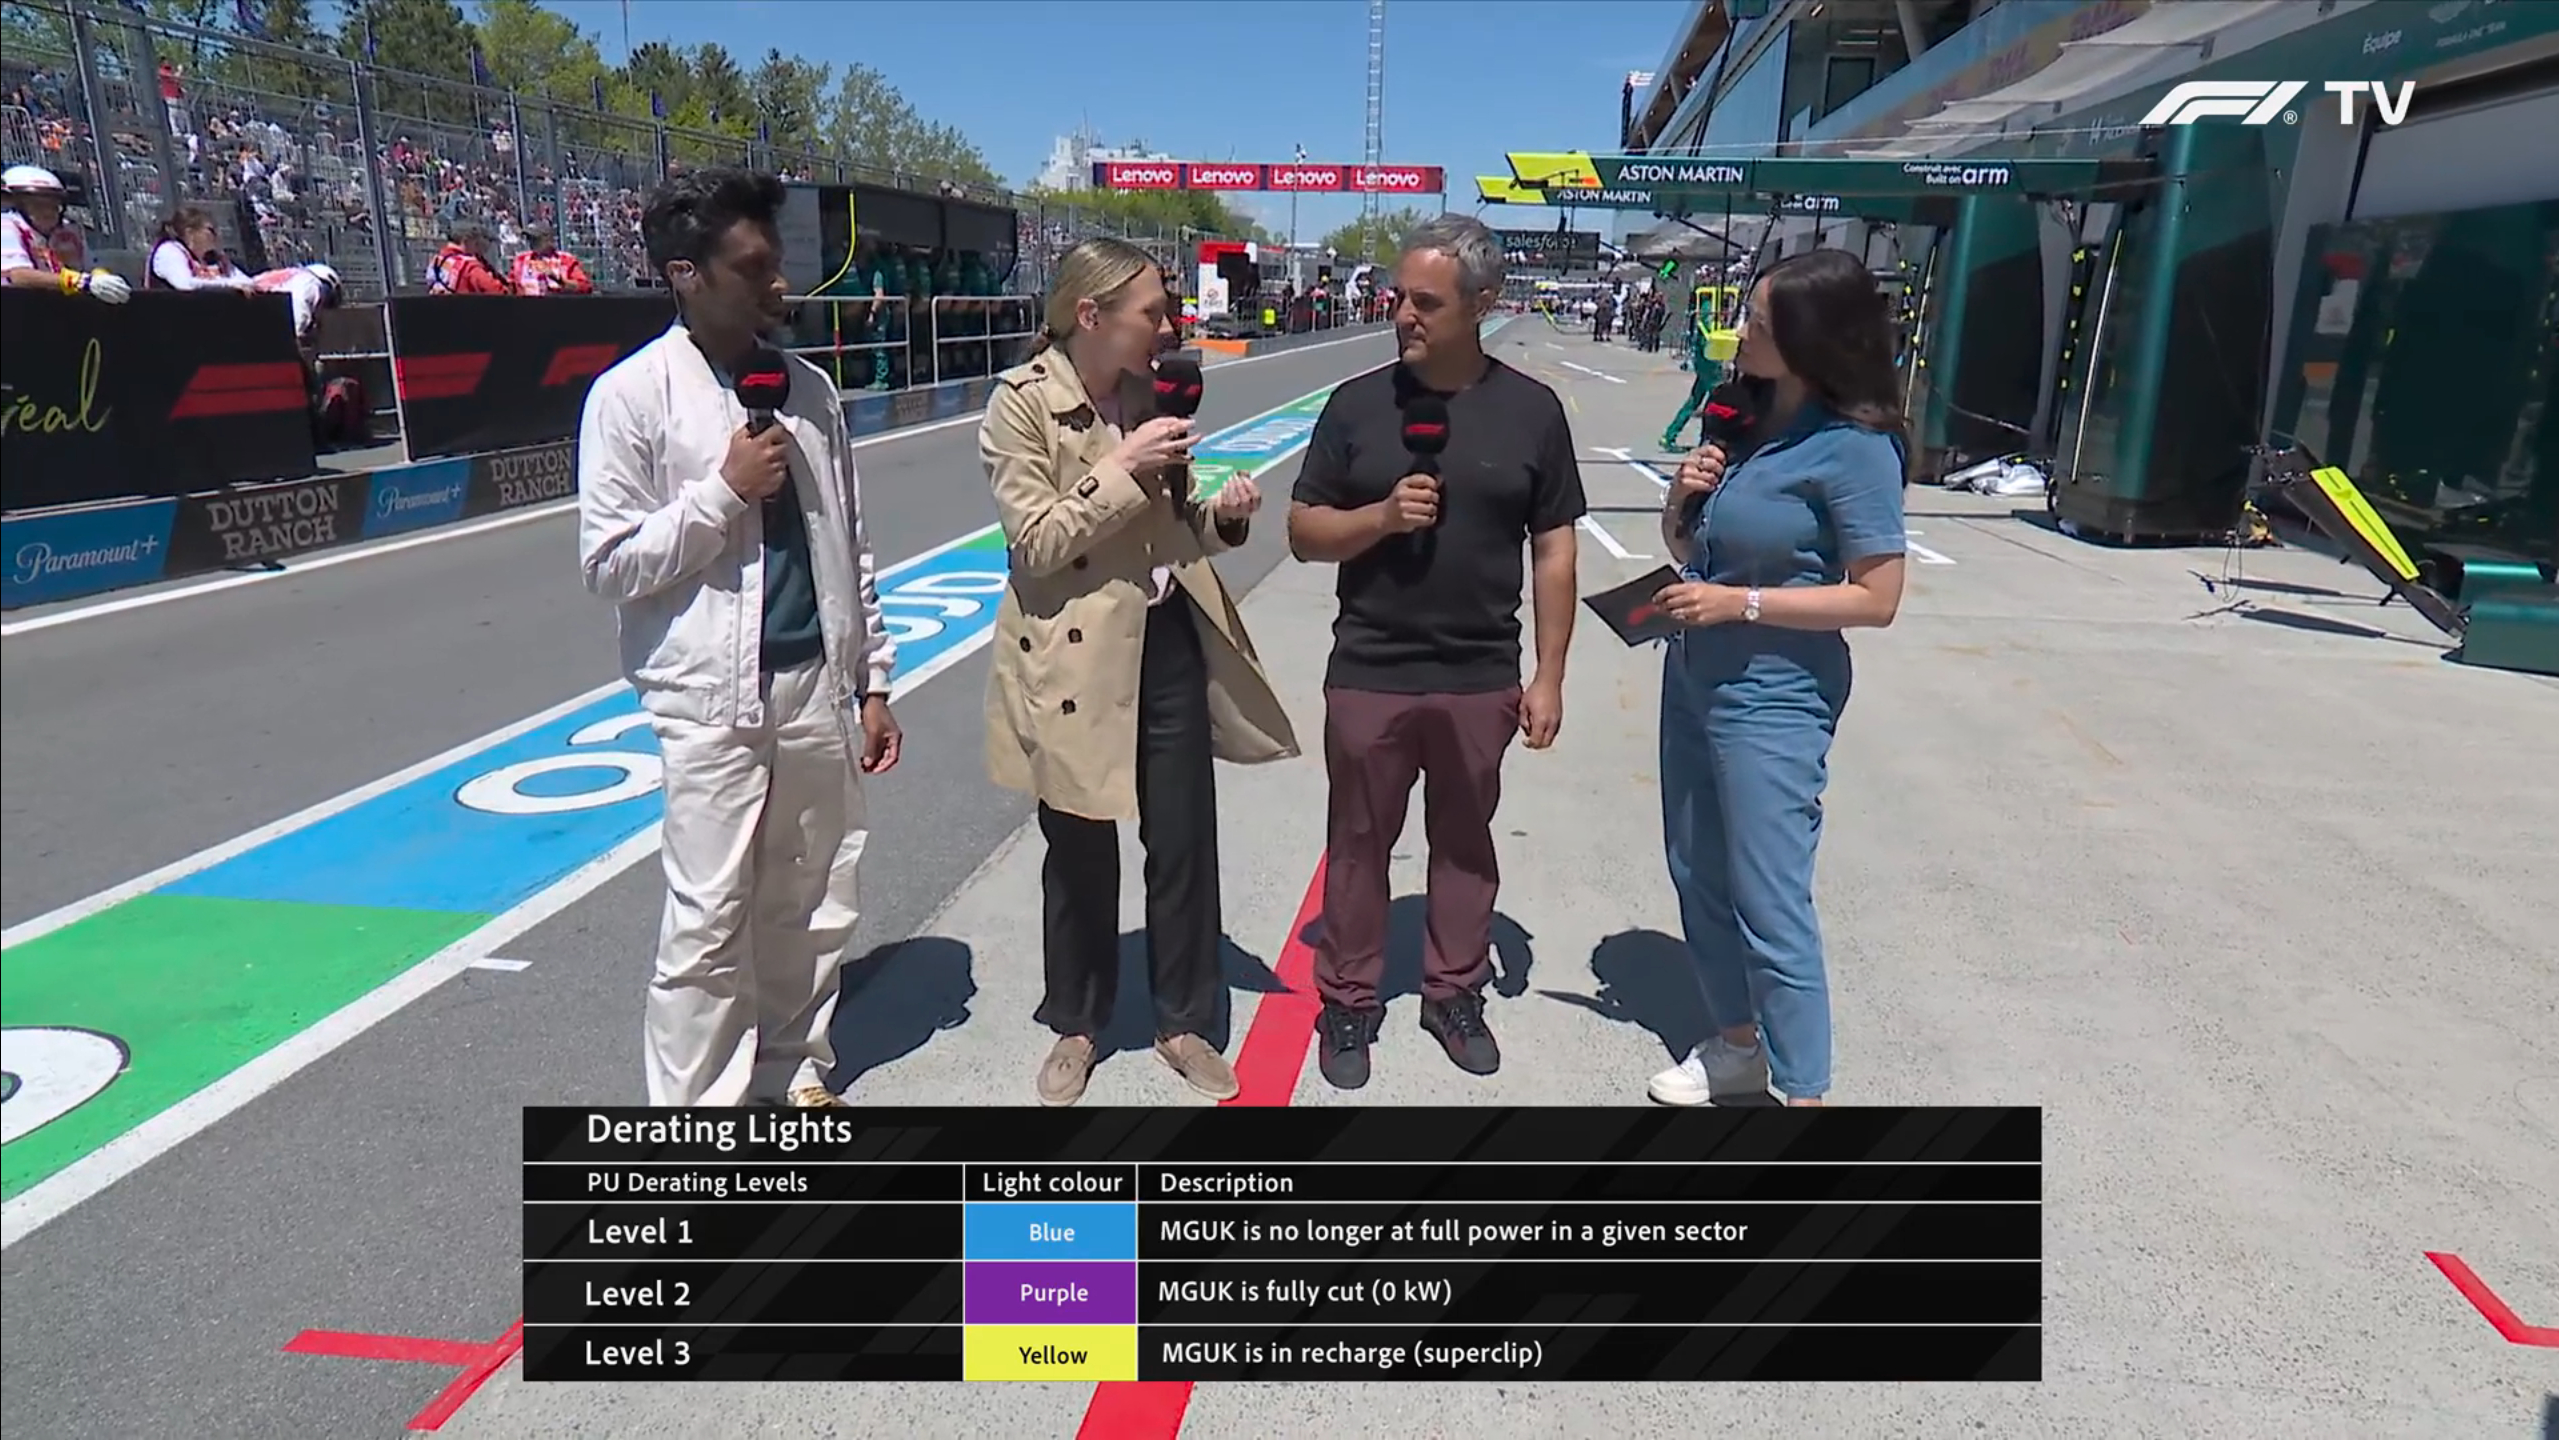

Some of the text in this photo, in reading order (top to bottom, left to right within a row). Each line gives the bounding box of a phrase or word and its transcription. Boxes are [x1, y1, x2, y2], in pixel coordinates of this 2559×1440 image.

[1112, 166, 1174, 184] Lenovo
[1192, 167, 1255, 184] Lenovo
[1273, 168, 1337, 185] Lenovo
[1356, 168, 1421, 187] Lenovo
[1617, 164, 1675, 182] ASTON
[1677, 166, 1745, 183] MARTIN
[1962, 166, 2009, 185] arm
[1602, 189, 1652, 203] MARTIN
[489, 447, 573, 482] DUTTON
[499, 472, 572, 506] RANCH
[205, 482, 340, 531] DUTTON
[376, 480, 462, 519] Paramount+
[221, 514, 336, 561] RANCH
[13, 534, 160, 585] Paramount+
